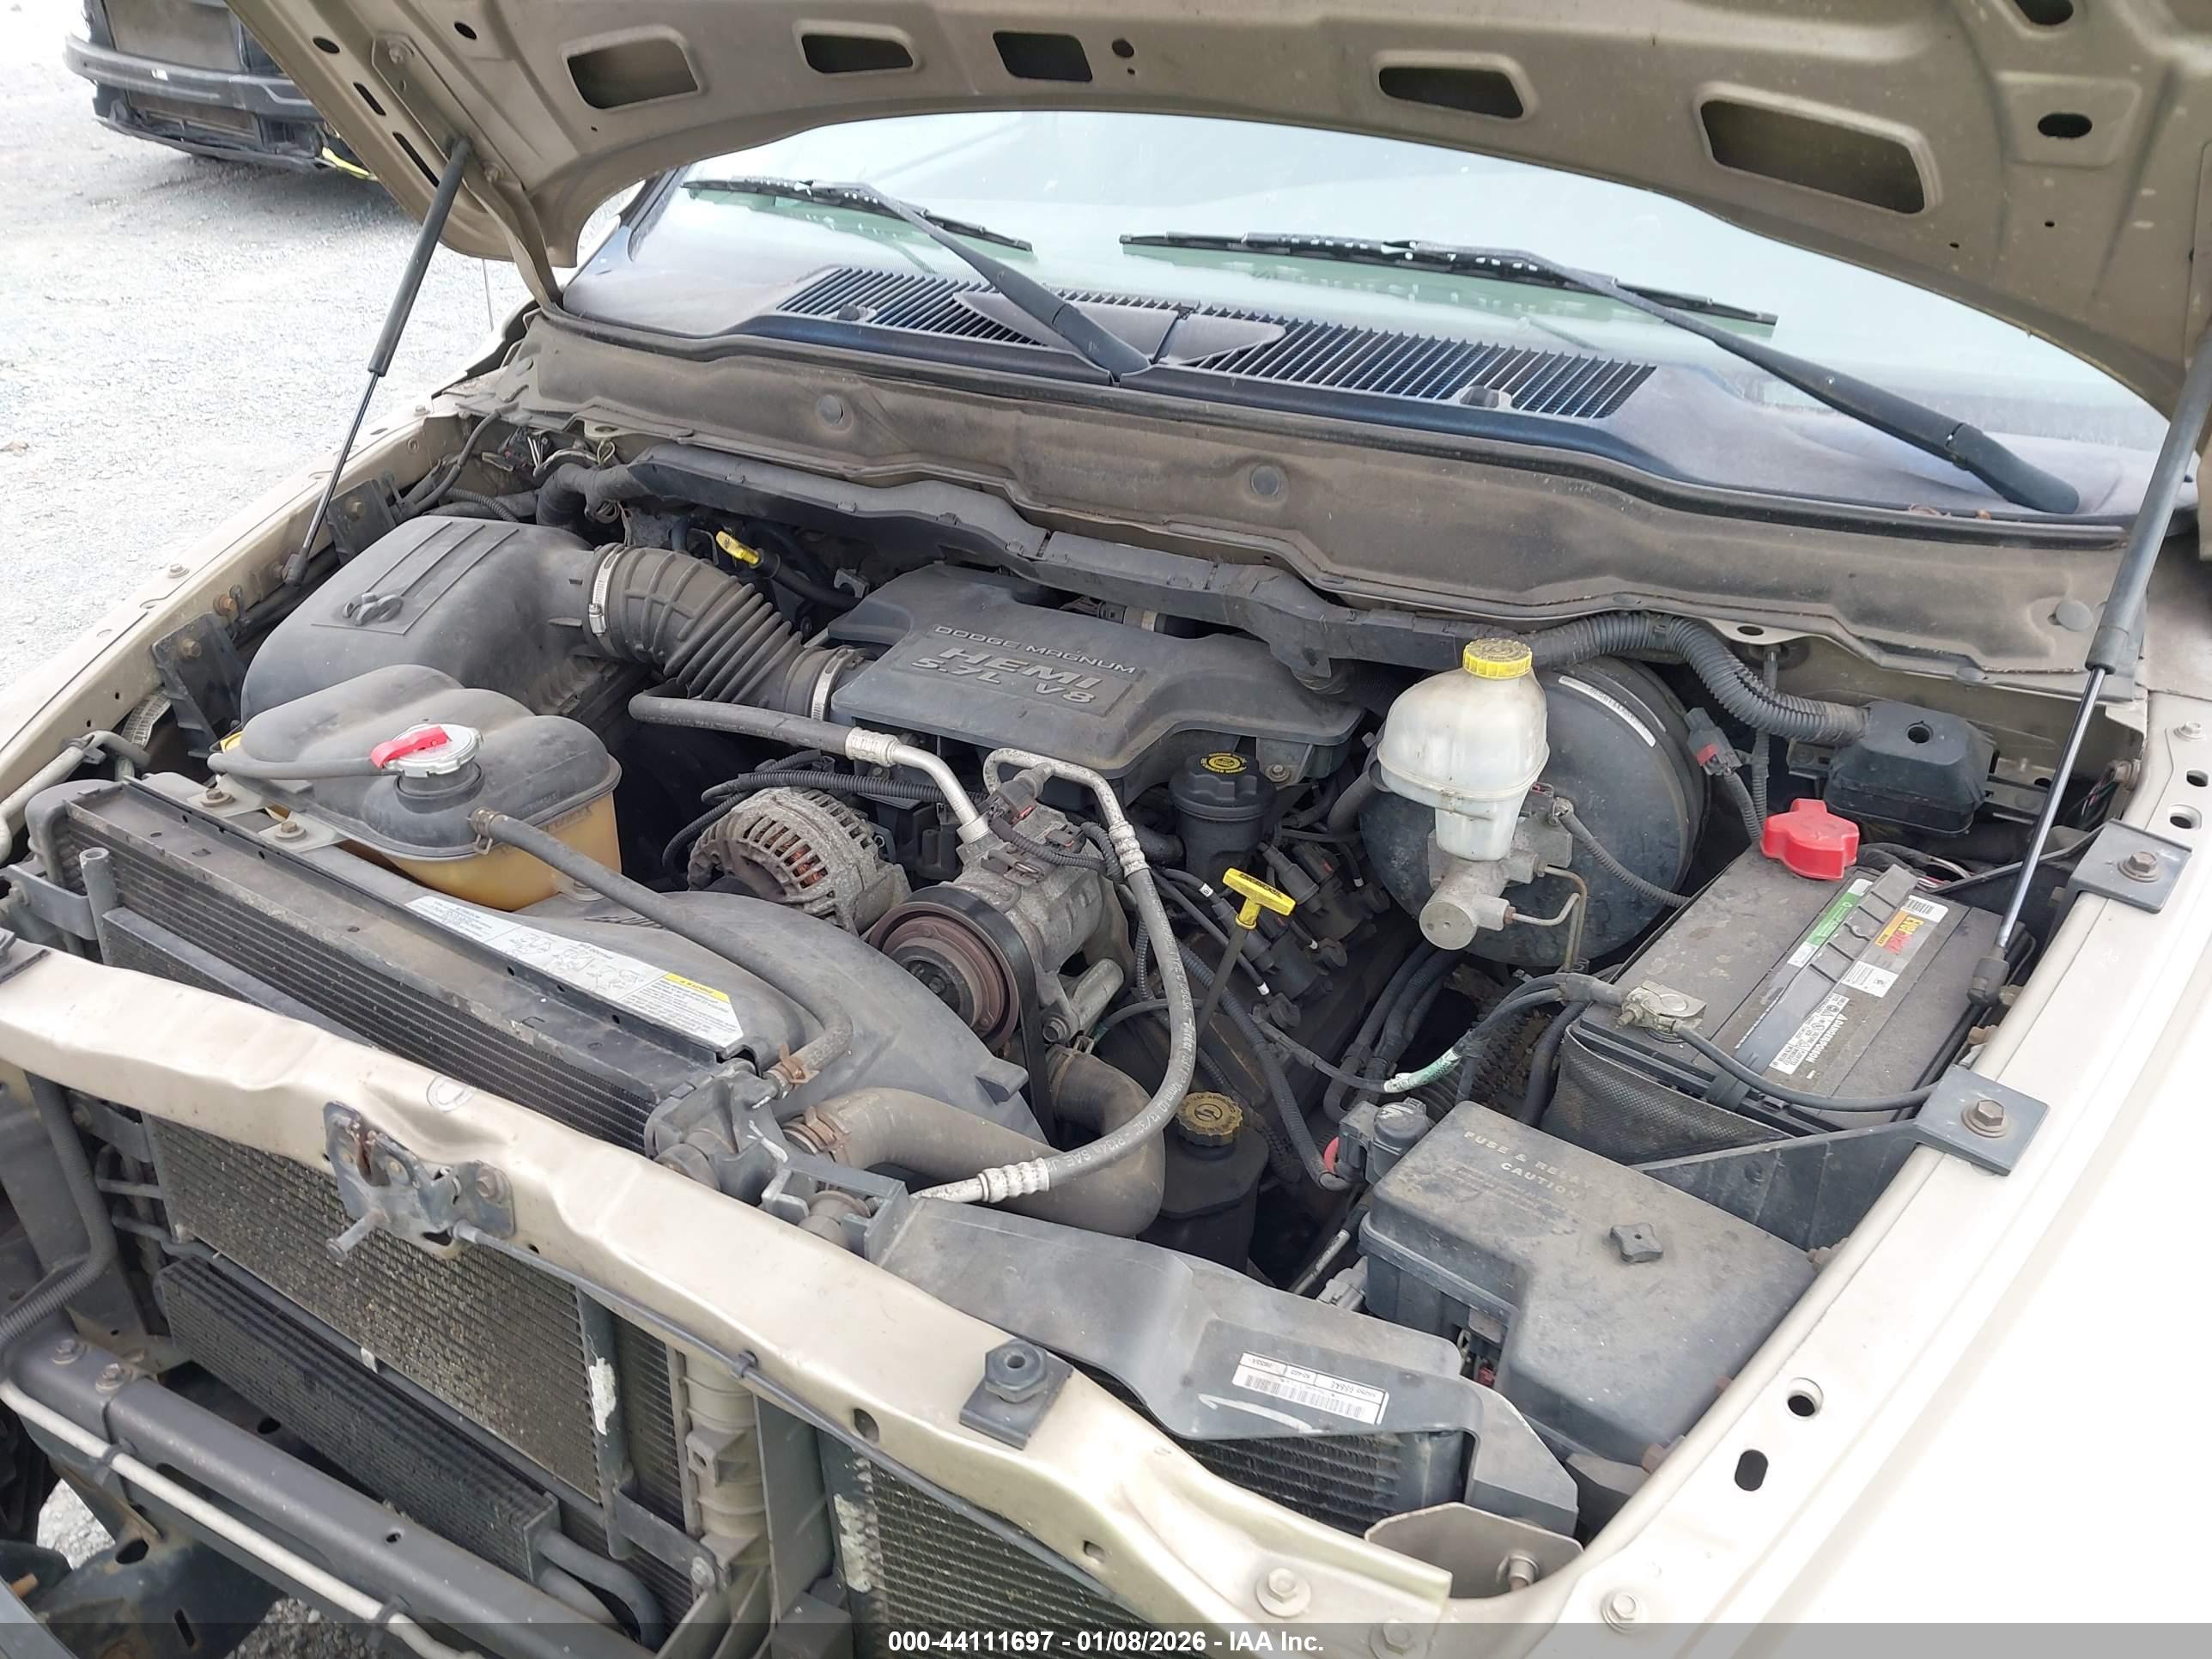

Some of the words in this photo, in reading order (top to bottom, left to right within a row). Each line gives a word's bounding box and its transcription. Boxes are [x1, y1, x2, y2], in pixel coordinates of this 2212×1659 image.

[934, 625, 1023, 650] DODGE
[1026, 645, 1138, 674] MAGNUM
[939, 647, 1103, 690] HEMI
[911, 657, 1002, 684] 5.7L
[1035, 683, 1097, 704] V8
[1062, 1147, 1091, 1167] SAE
[1463, 1131, 1510, 1154] FUSE
[1514, 1153, 1527, 1163] &
